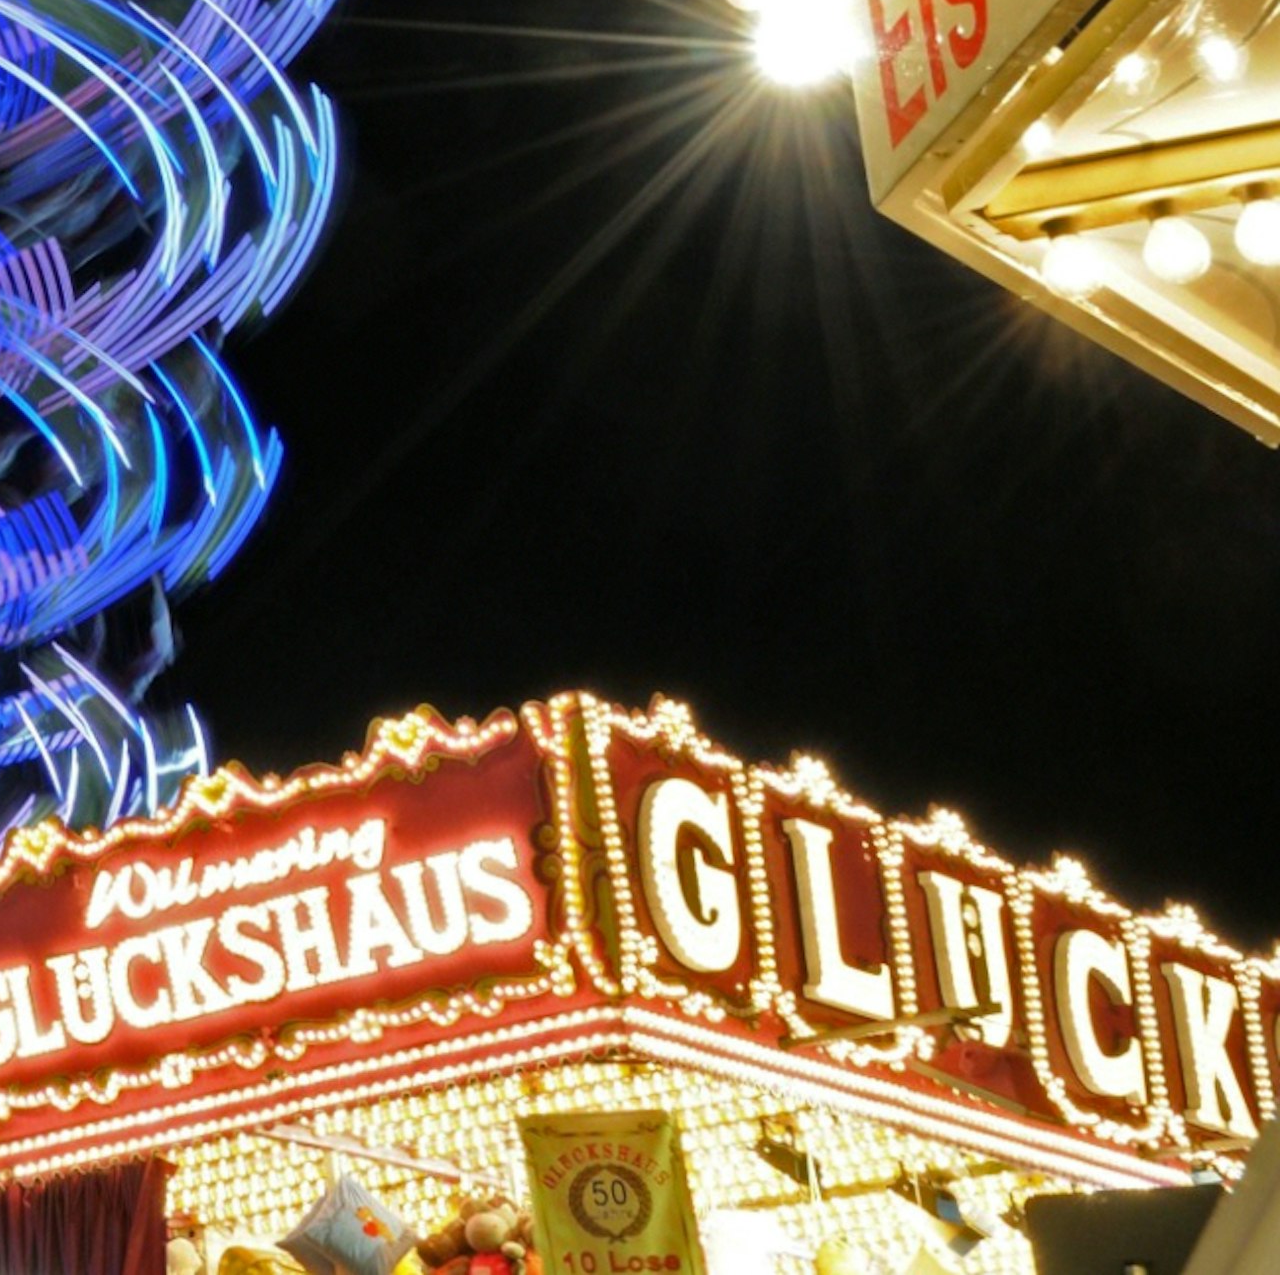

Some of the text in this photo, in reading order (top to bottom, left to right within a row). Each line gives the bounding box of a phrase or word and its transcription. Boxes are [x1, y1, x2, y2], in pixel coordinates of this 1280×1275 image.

[640, 777, 1280, 1139] GLÜCK
[591, 1179, 628, 1207] 50
[562, 1250, 597, 1275] 10
